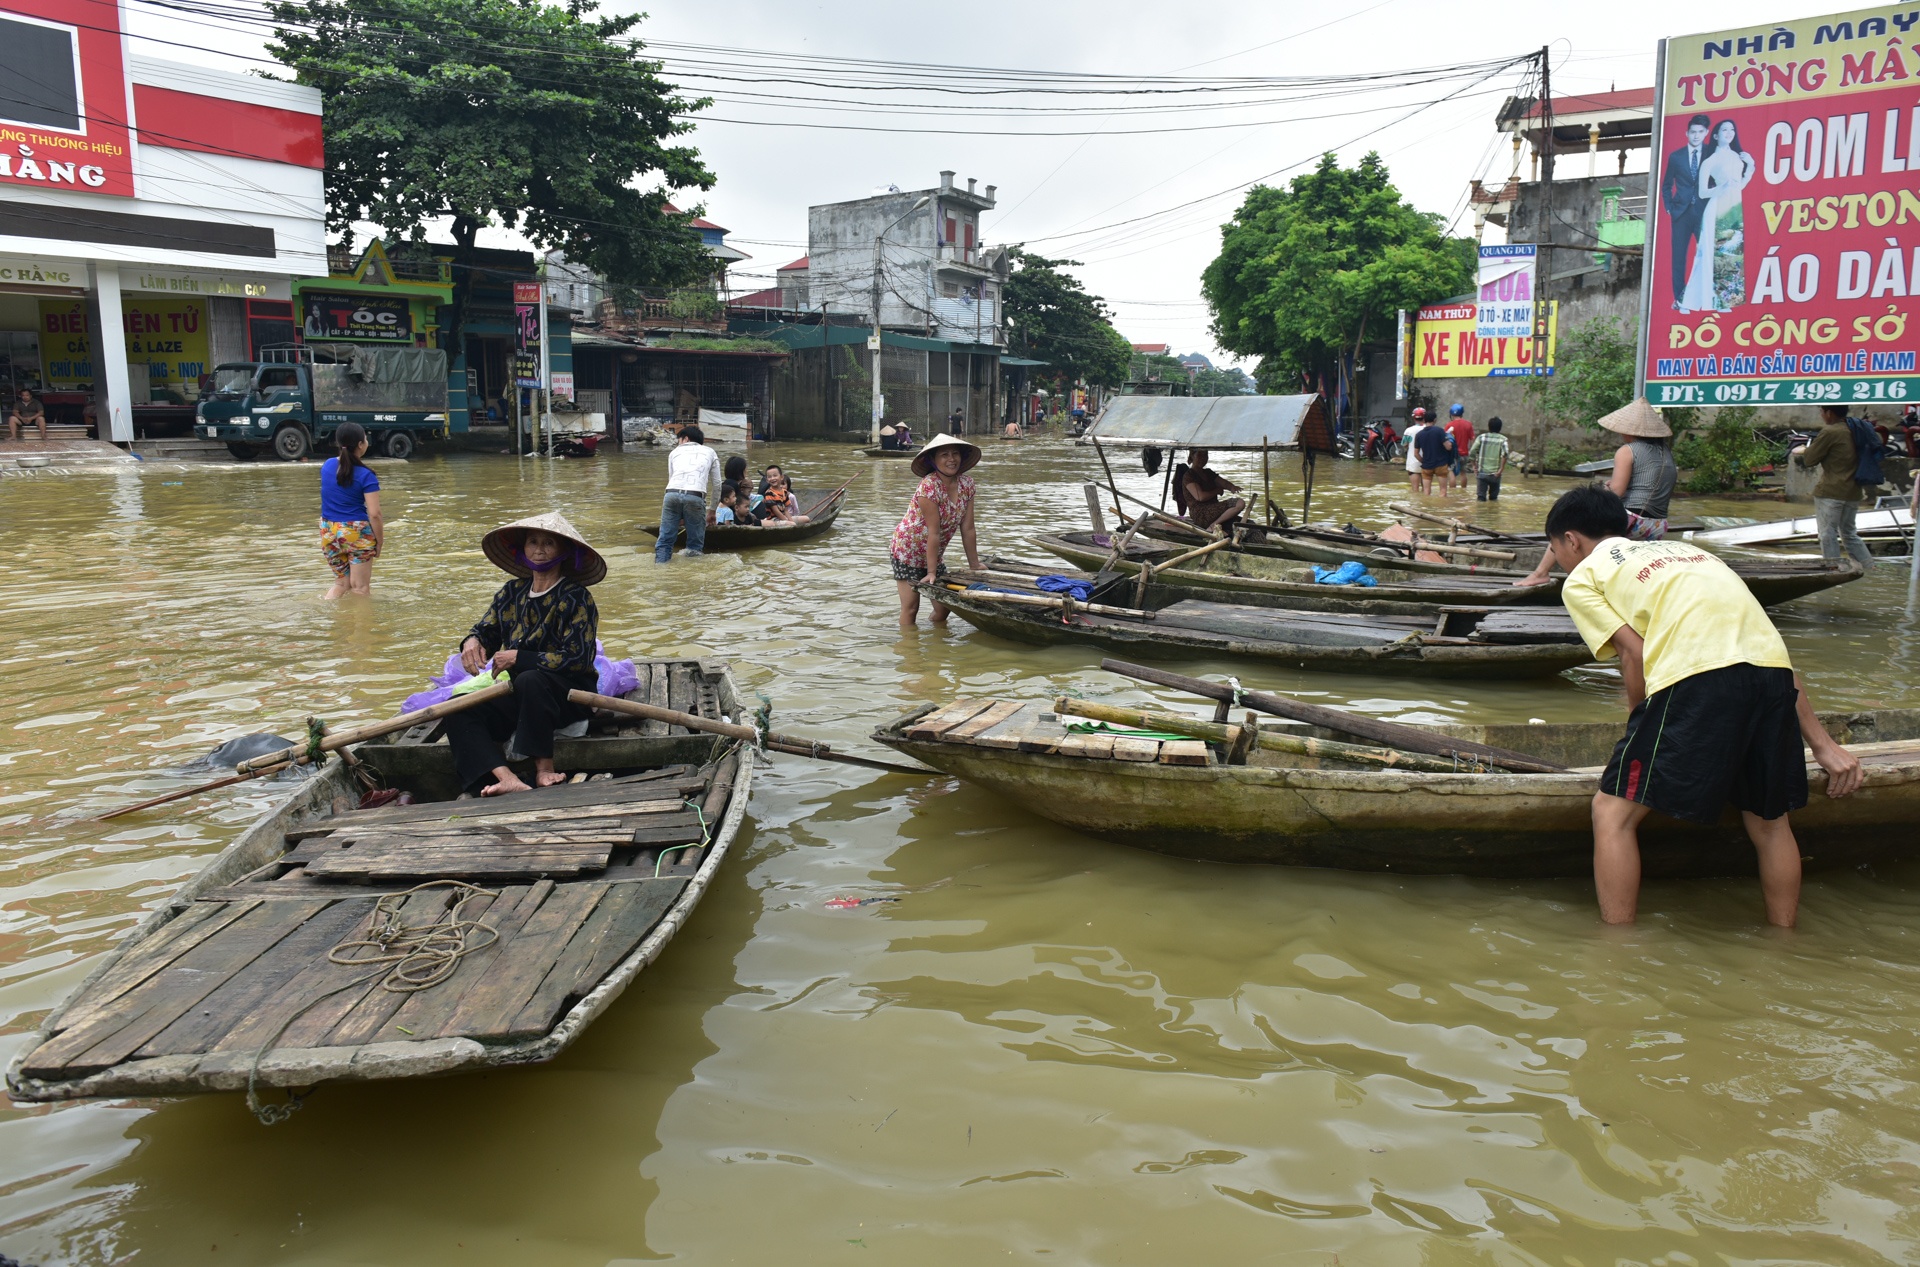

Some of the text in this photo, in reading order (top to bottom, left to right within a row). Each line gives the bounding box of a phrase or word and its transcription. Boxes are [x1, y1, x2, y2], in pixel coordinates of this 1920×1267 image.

[1703, 11, 1920, 60] NHÀ MAY
[1677, 37, 1920, 107] TƯỜNG MÂ
[29, 133, 89, 151] THƯƠNG
[91, 142, 122, 157] HIỆU
[1763, 111, 1869, 185] COM
[1481, 246, 1534, 257] QUANG DUY
[17, 265, 71, 283] HẰNG
[140, 274, 167, 289] LÀM
[170, 275, 199, 291] BIỂN
[244, 282, 267, 296] CÁO
[1750, 246, 1820, 305] ÁO
[124, 309, 161, 339] IỆN
[168, 305, 199, 333] TỬ
[1419, 306, 1473, 319] NAM THỦY
[1502, 308, 1511, 322] XE
[1513, 305, 1531, 322] MÁY
[1478, 325, 1496, 336] CÔNG
[1516, 326, 1530, 335] CAO
[1668, 304, 1908, 349] ĐỒ CÔNG SỞ
[147, 341, 183, 353] LAZE
[1422, 332, 1450, 366] XE
[50, 359, 71, 378] CHỮ
[178, 362, 204, 378] INOX
[1657, 349, 1915, 377] MAY VÀ BÁN SẴN COM LÊ NAM
[1661, 381, 1907, 402] ĐT: 0917 492 216
